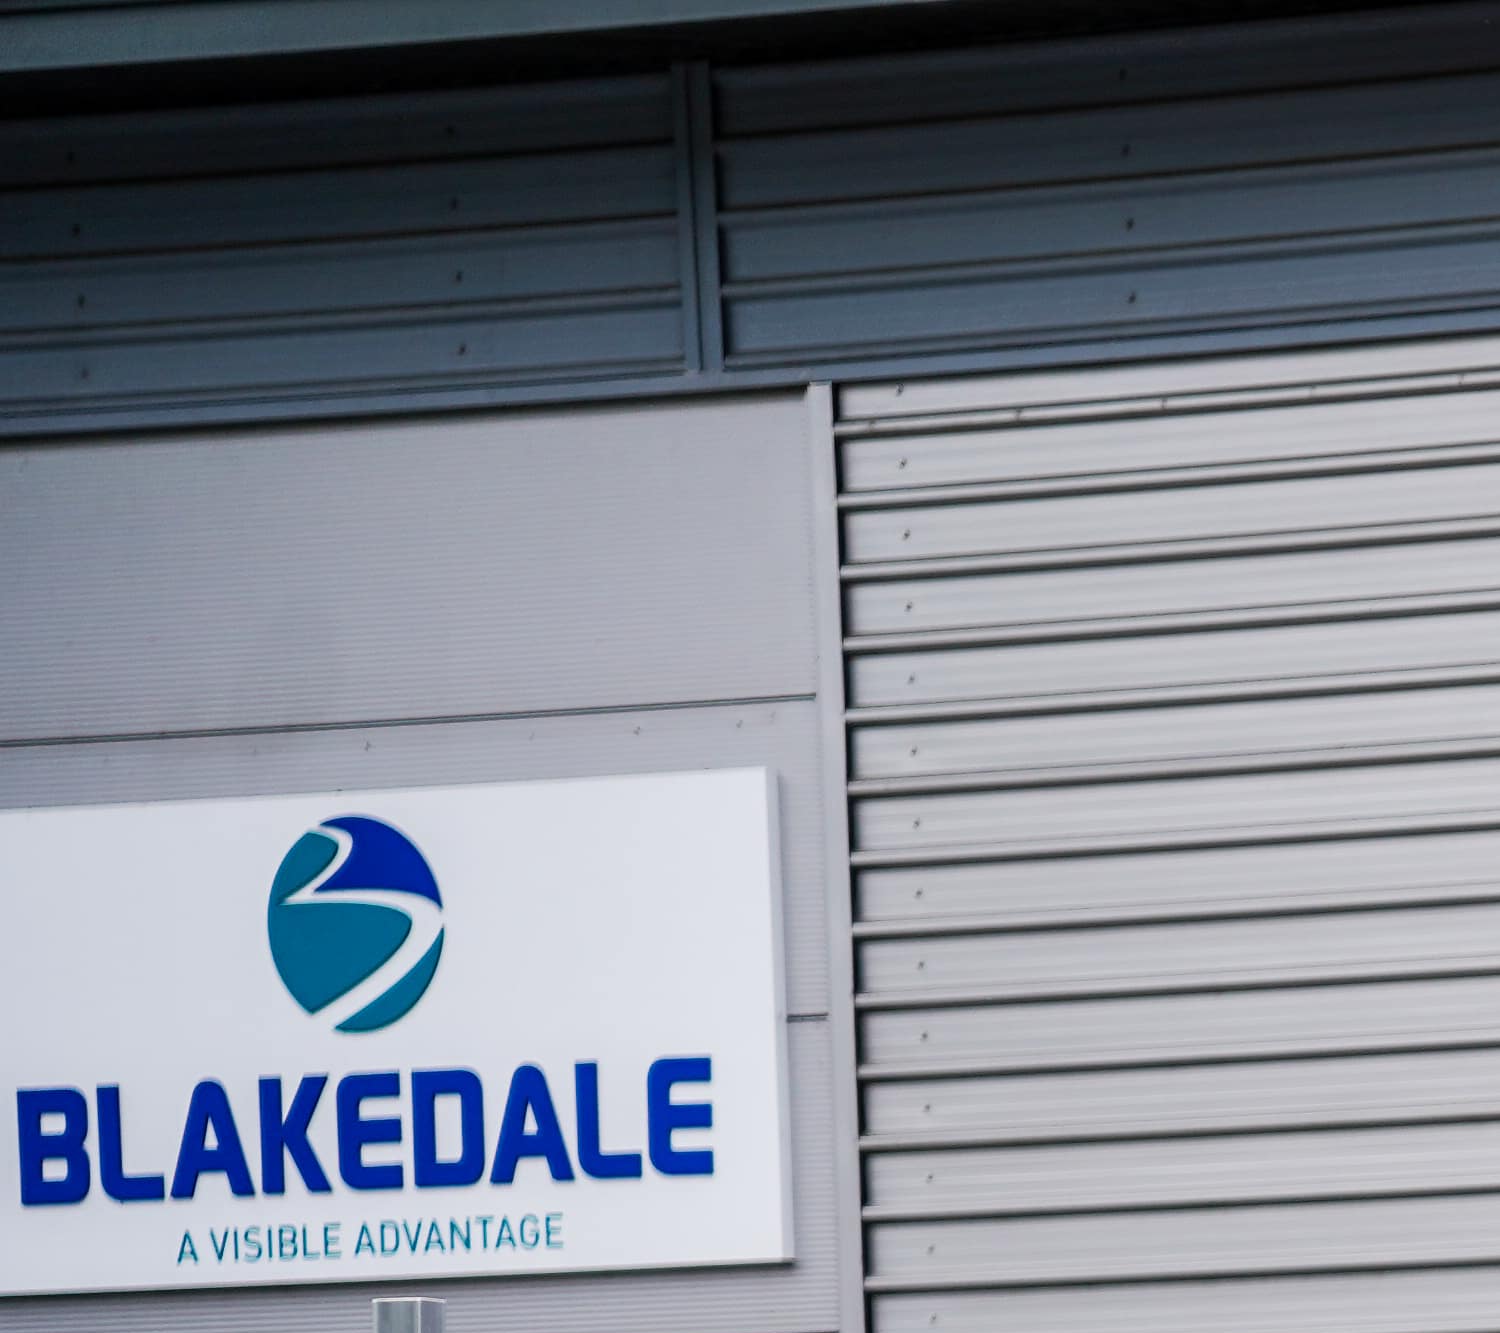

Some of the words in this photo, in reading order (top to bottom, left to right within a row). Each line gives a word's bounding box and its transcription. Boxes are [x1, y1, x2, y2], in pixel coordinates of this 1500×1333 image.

[16, 1056, 714, 1206] BLAKEDALE
[177, 1231, 200, 1265] A
[210, 1222, 342, 1264] VISIBLE
[354, 1212, 564, 1258] ADVANTAGE
